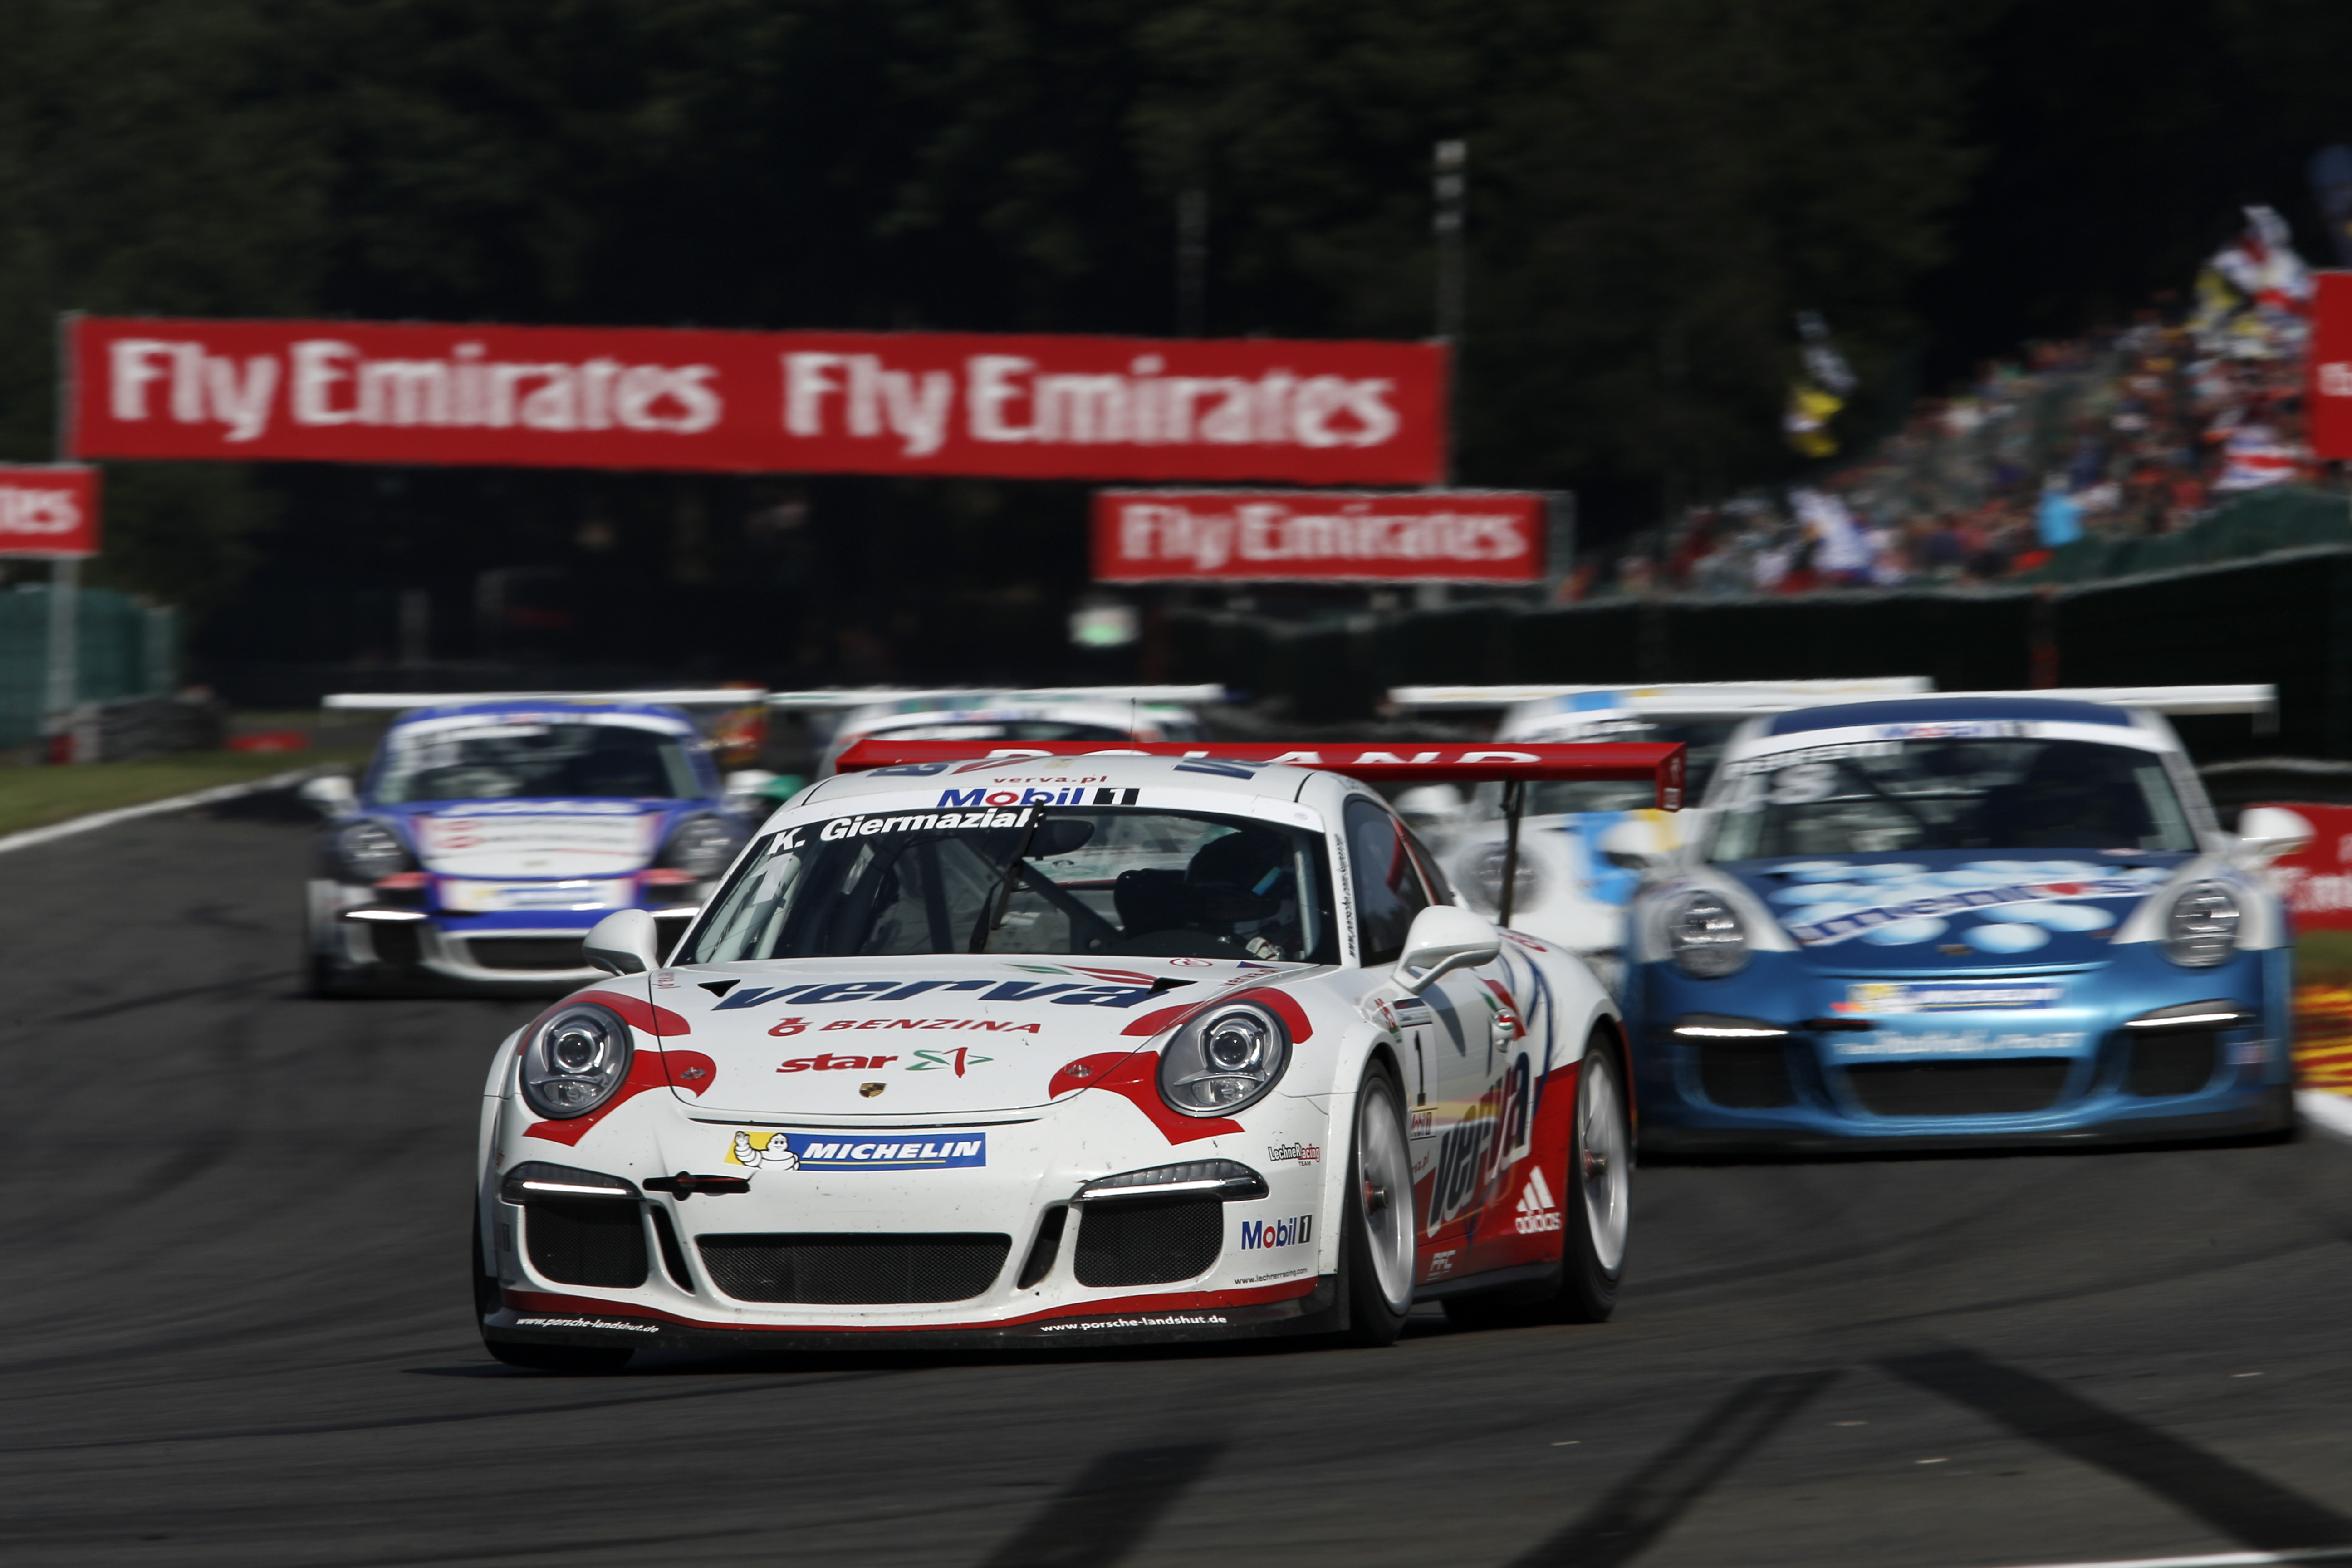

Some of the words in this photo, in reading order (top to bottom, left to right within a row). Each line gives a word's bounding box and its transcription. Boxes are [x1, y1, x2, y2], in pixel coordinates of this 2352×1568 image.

[110, 338, 279, 444] Fly
[290, 339, 721, 434] Emirates
[781, 351, 953, 456] Fly
[966, 355, 1400, 448] Emirates
[1119, 504, 1235, 569] Fly
[1235, 502, 1525, 561] Emirates
[993, 774, 1108, 784] verva.pl
[936, 787, 1085, 807] Mobil
[767, 829, 806, 856] K.
[710, 980, 1171, 1012] verva
[818, 1018, 1041, 1034] BENZINA
[775, 1053, 899, 1073] star
[1414, 1030, 1426, 1106] 1
[802, 1140, 982, 1160] MICHELIN
[1428, 1052, 1533, 1236] verva
[1241, 1217, 1297, 1250] Mobil
[1515, 1209, 1562, 1235] adidas
[1234, 1267, 1308, 1285] www.lechnerracing.com
[515, 1317, 660, 1333] www.porsche-landshut.de
[1040, 1314, 1228, 1332] www.porsche-landshut.de
